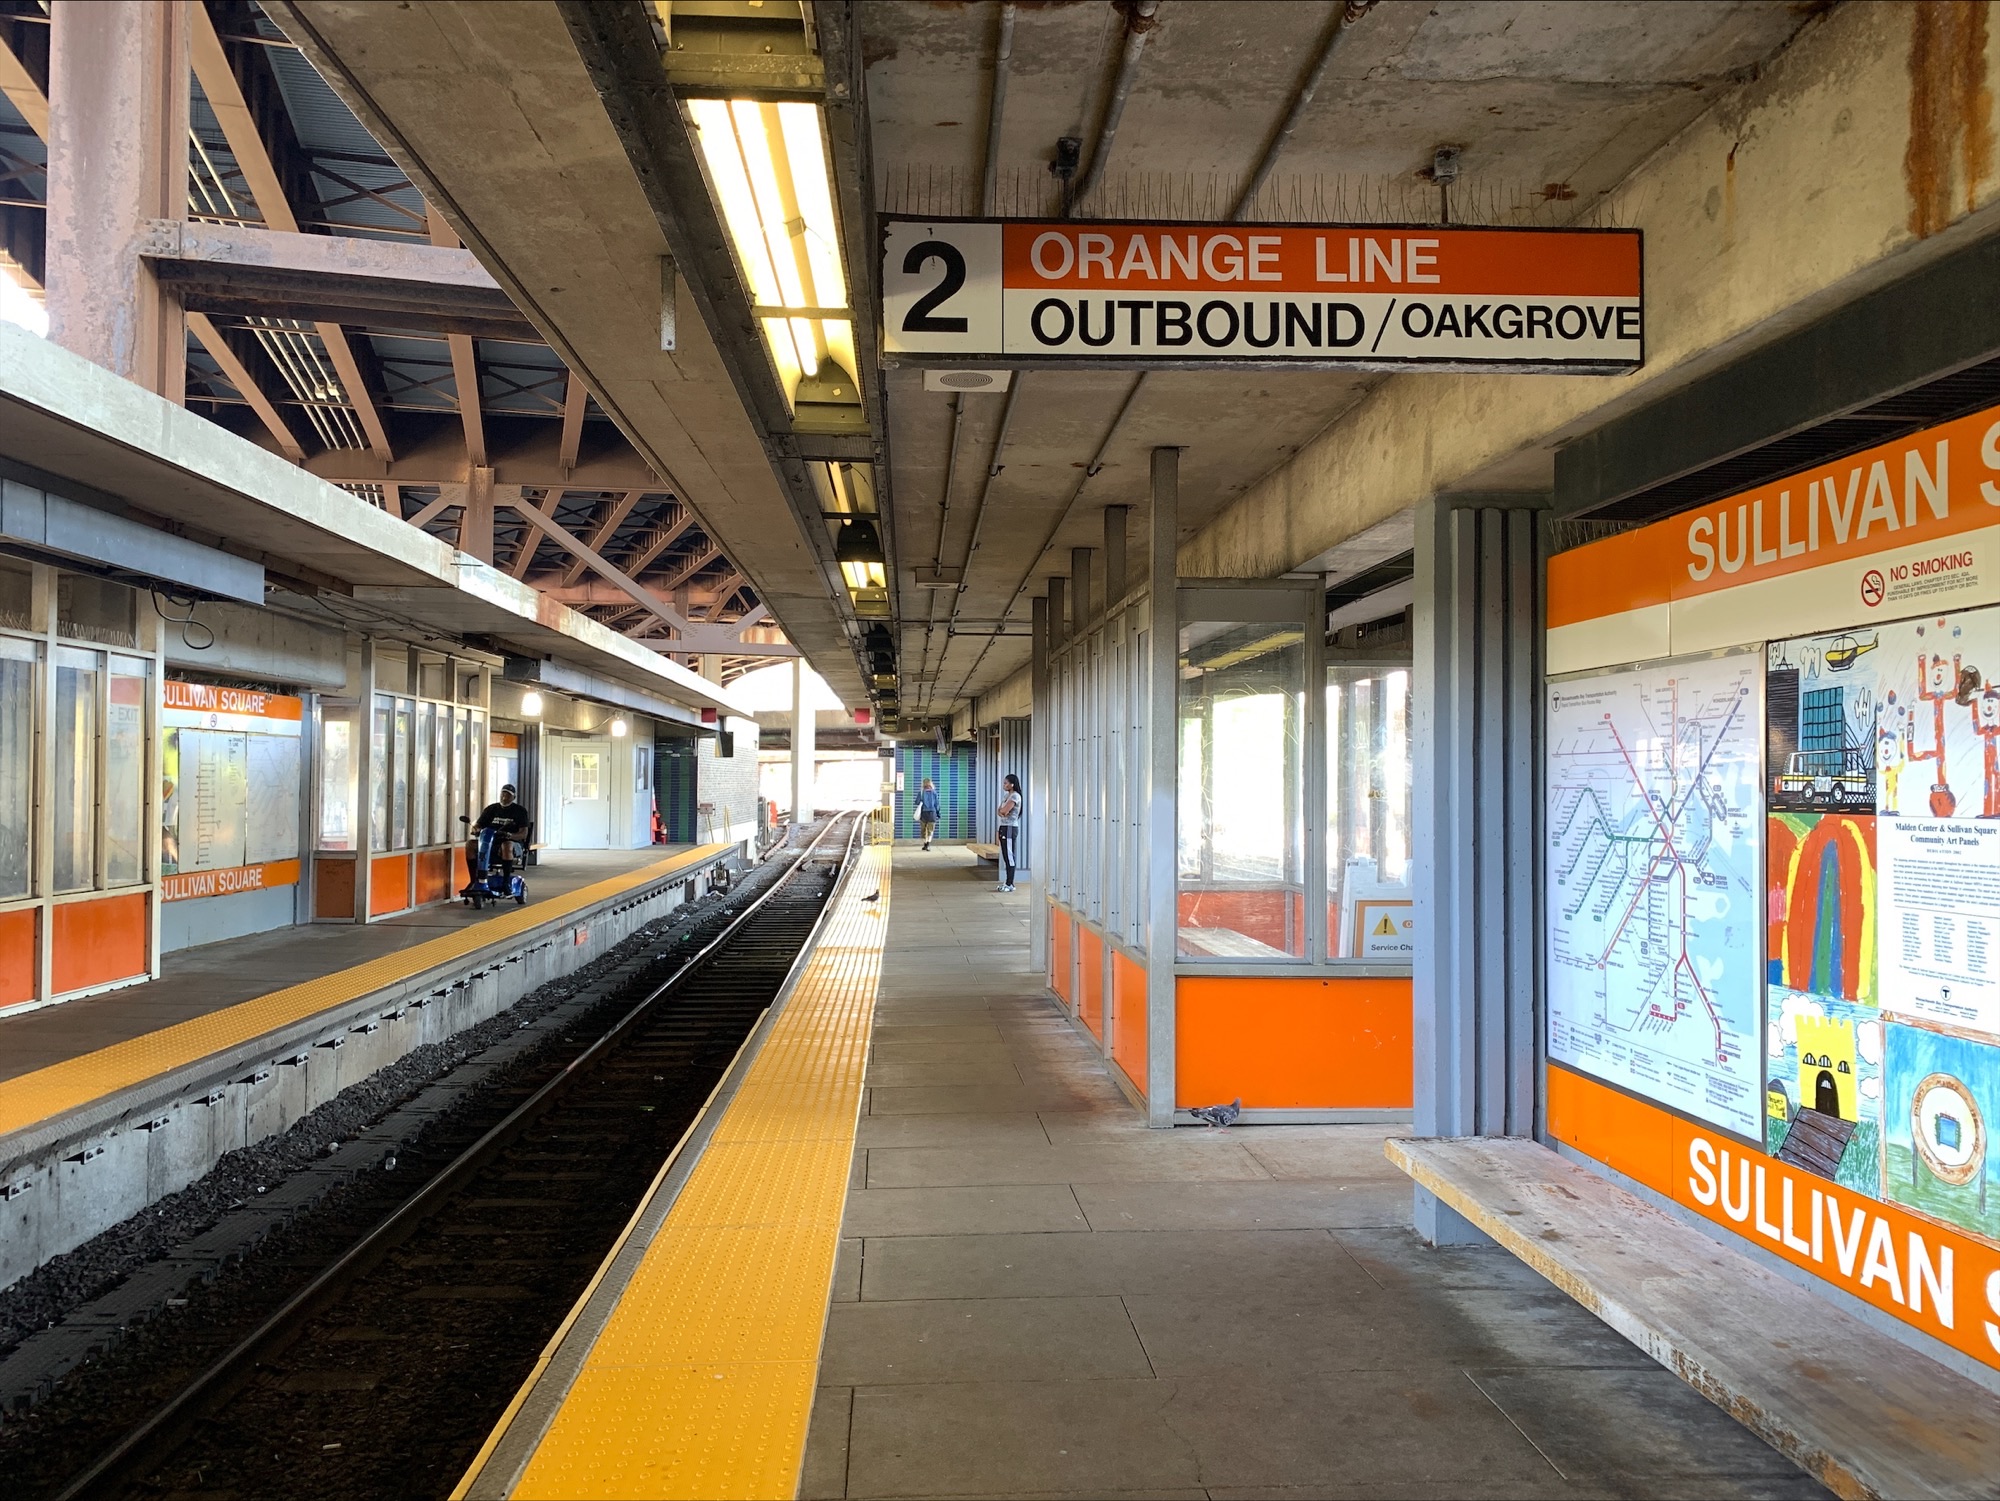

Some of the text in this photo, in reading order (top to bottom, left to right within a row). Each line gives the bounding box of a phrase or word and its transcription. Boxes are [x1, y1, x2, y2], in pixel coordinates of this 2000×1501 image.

[1030, 231, 1441, 285] ORANGE LINE
[901, 240, 969, 332] 2
[1687, 439, 1949, 582] SULLIVAN
[1890, 551, 1973, 582] NO SMOKING
[118, 706, 138, 721] EXIT
[221, 690, 265, 714] SQUARE
[1896, 823, 1916, 831] Malden
[1918, 824, 1938, 832] Center
[1947, 825, 1972, 834] Sullivan
[1974, 826, 1997, 836] Square
[1910, 835, 1945, 846] Community
[1960, 837, 1979, 846] Panels
[219, 868, 262, 892] SQUARE
[1689, 1137, 1954, 1330] SULLIVAN
